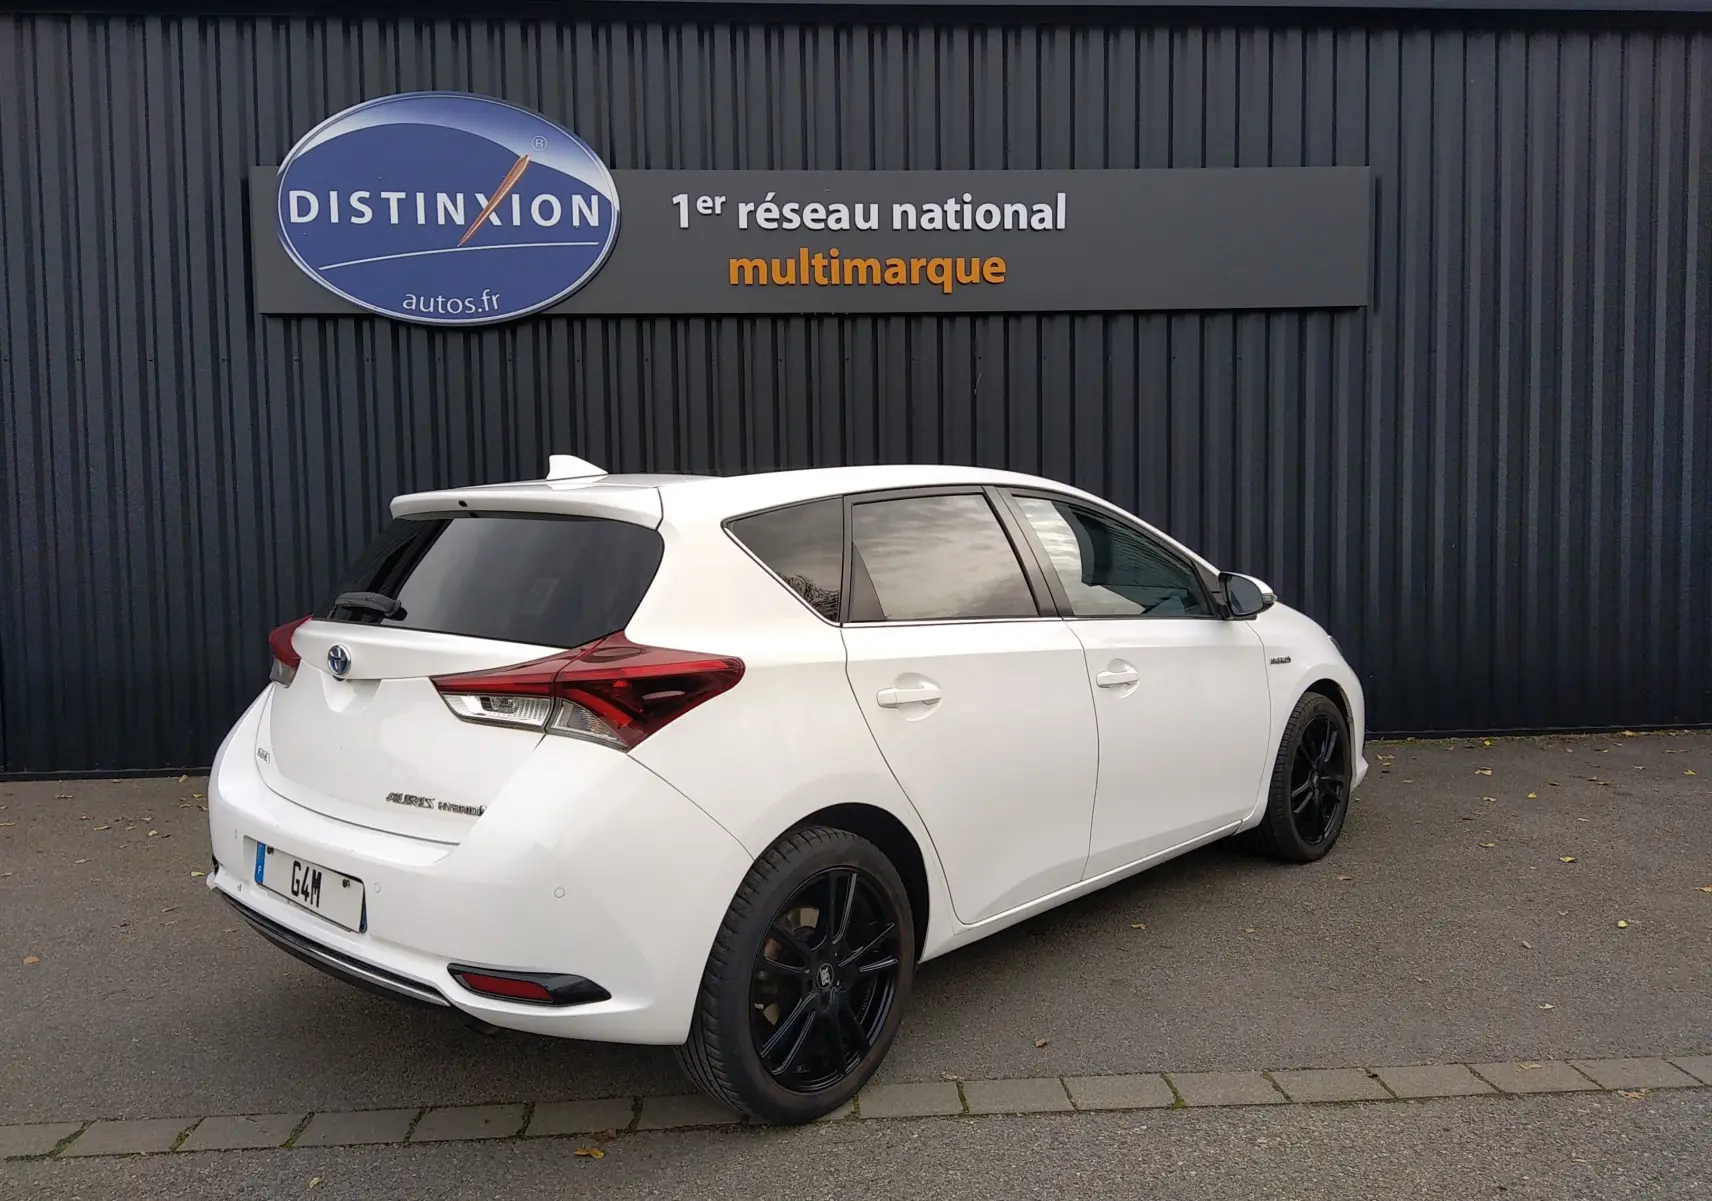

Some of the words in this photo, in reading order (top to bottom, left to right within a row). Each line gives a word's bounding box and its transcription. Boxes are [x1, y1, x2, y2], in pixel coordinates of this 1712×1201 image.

[288, 189, 600, 228] DISTINXION
[672, 192, 726, 229] 1er
[737, 192, 879, 231] réseau
[892, 192, 1067, 231] national
[728, 247, 1007, 295] multimarque
[402, 288, 501, 315] autos.fr
[291, 860, 323, 908] G4M
